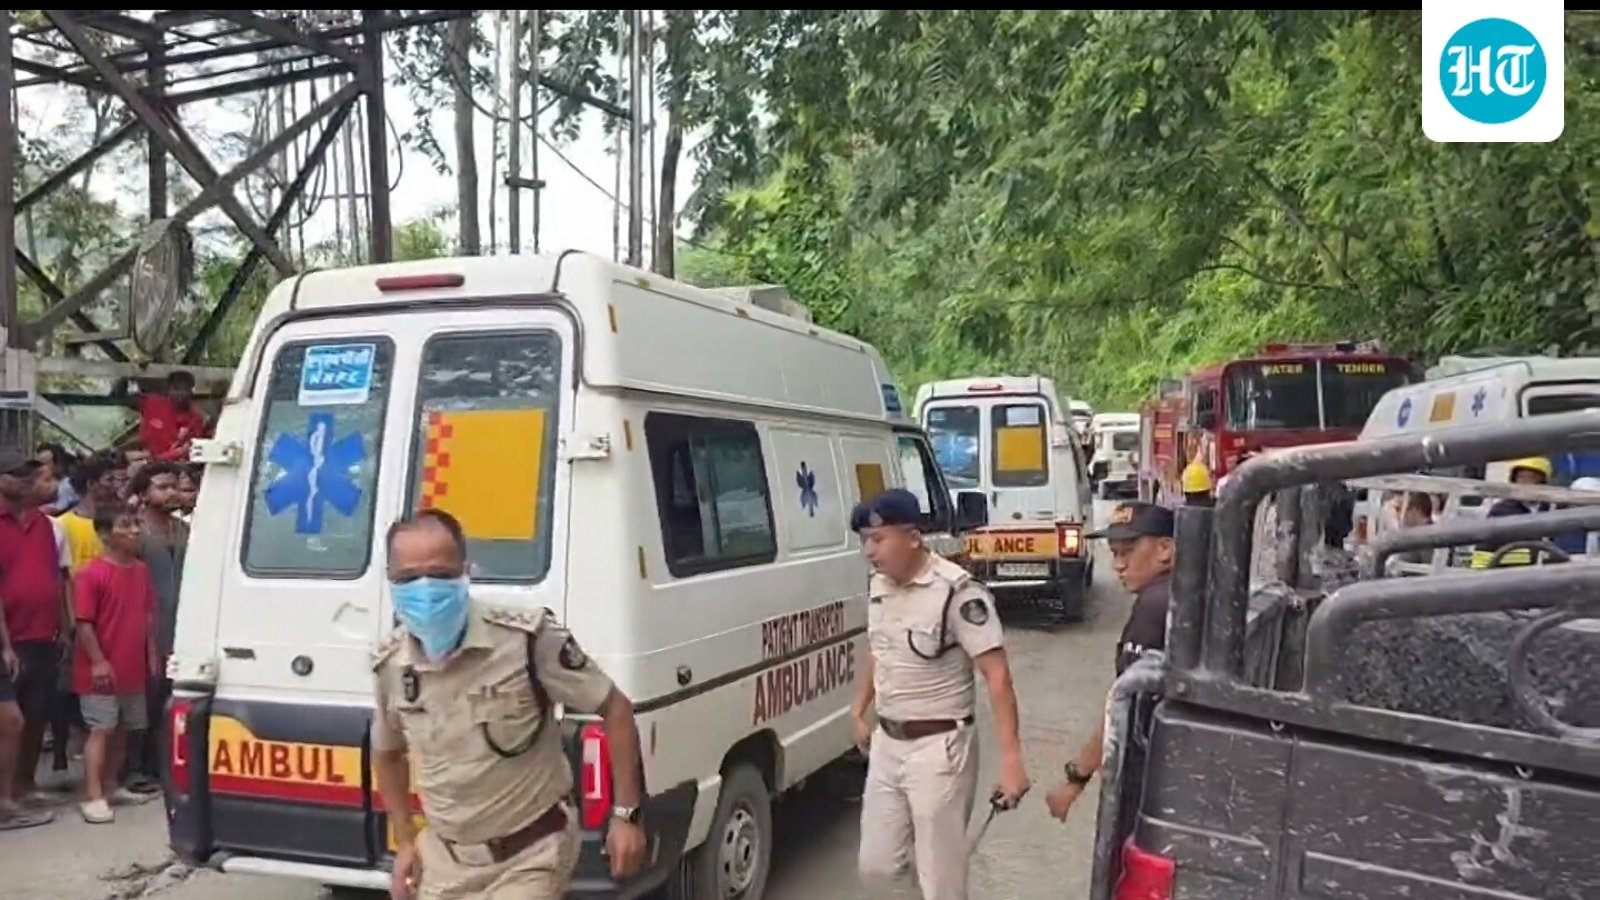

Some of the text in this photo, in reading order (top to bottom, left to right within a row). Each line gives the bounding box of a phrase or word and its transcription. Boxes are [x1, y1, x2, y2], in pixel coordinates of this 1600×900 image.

[1261, 363, 1386, 377] WATER TENDER
[761, 613, 799, 660] PATIENT
[753, 641, 855, 726] AMBULANCE
[212, 739, 346, 783] AMBUL
